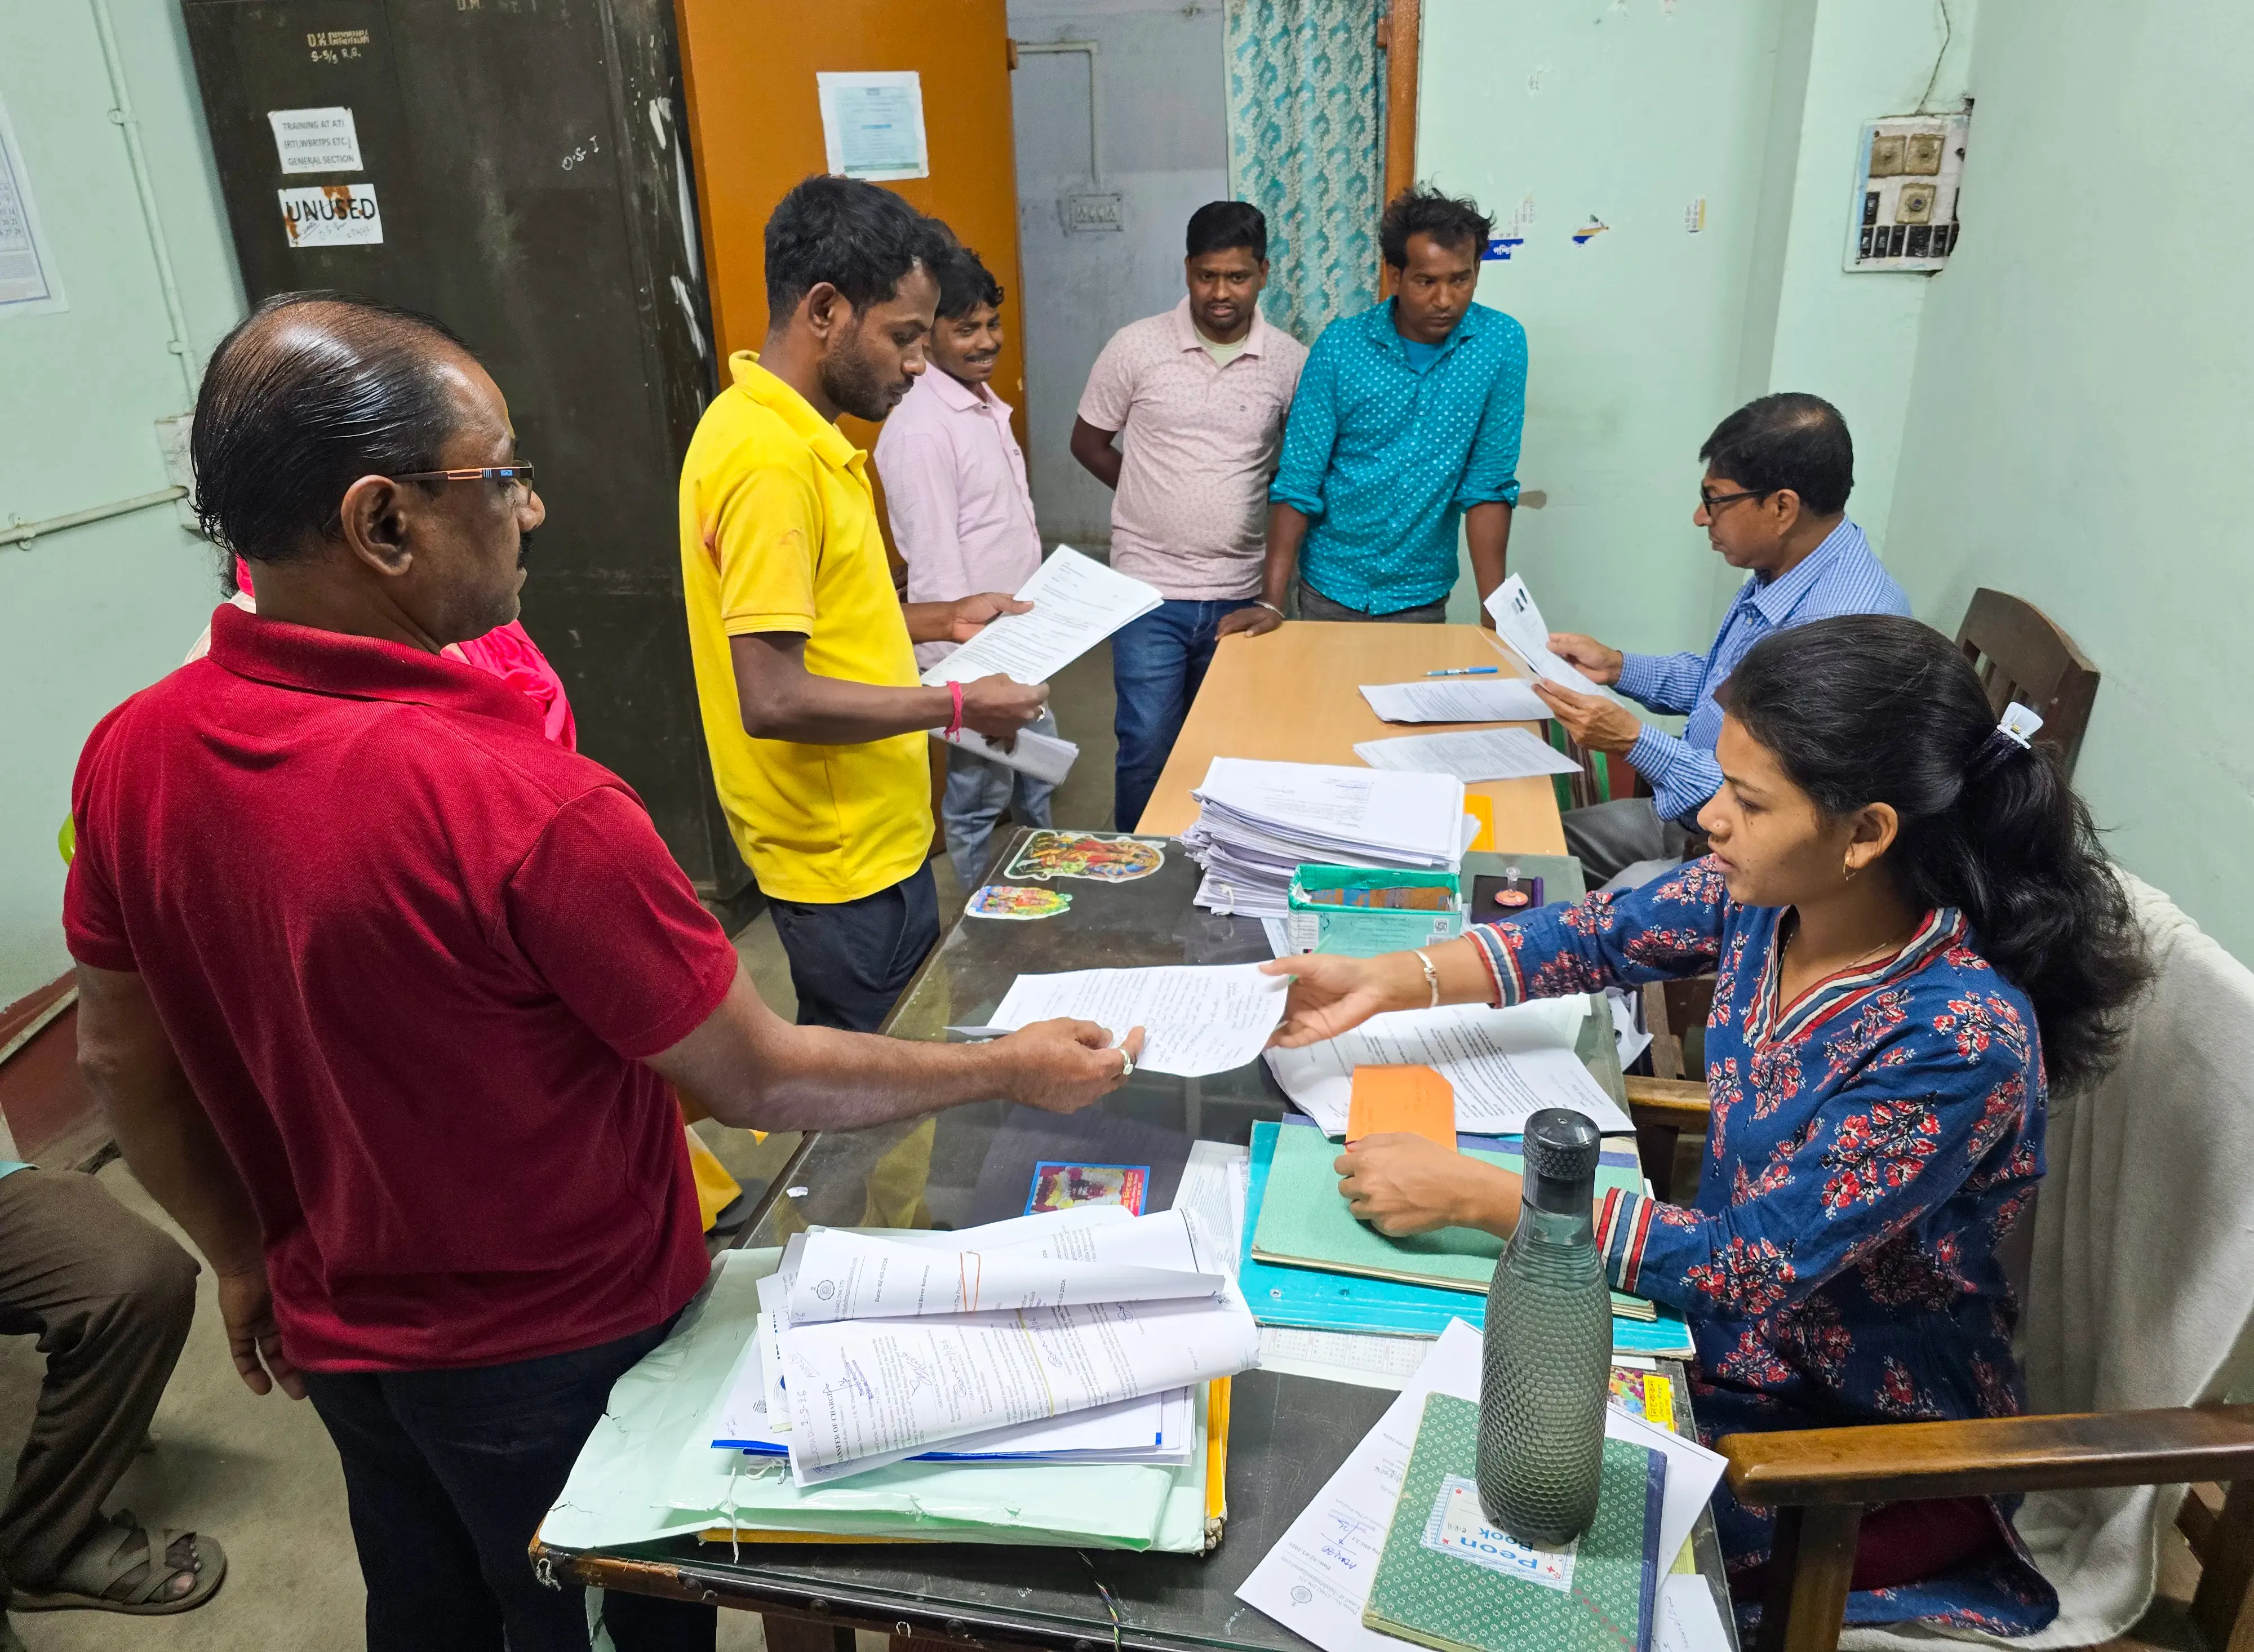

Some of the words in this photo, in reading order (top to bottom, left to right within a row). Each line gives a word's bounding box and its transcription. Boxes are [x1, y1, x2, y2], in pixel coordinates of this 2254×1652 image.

[286, 198, 376, 223] UNUSED
[920, 1264, 929, 1287] between
[827, 1391, 837, 1420] CHARGE
[832, 1422, 838, 1432] OF
[834, 1433, 843, 1462] RANSFER
[1477, 1527, 1534, 1552] Book
[1459, 1536, 1538, 1570] Peon
